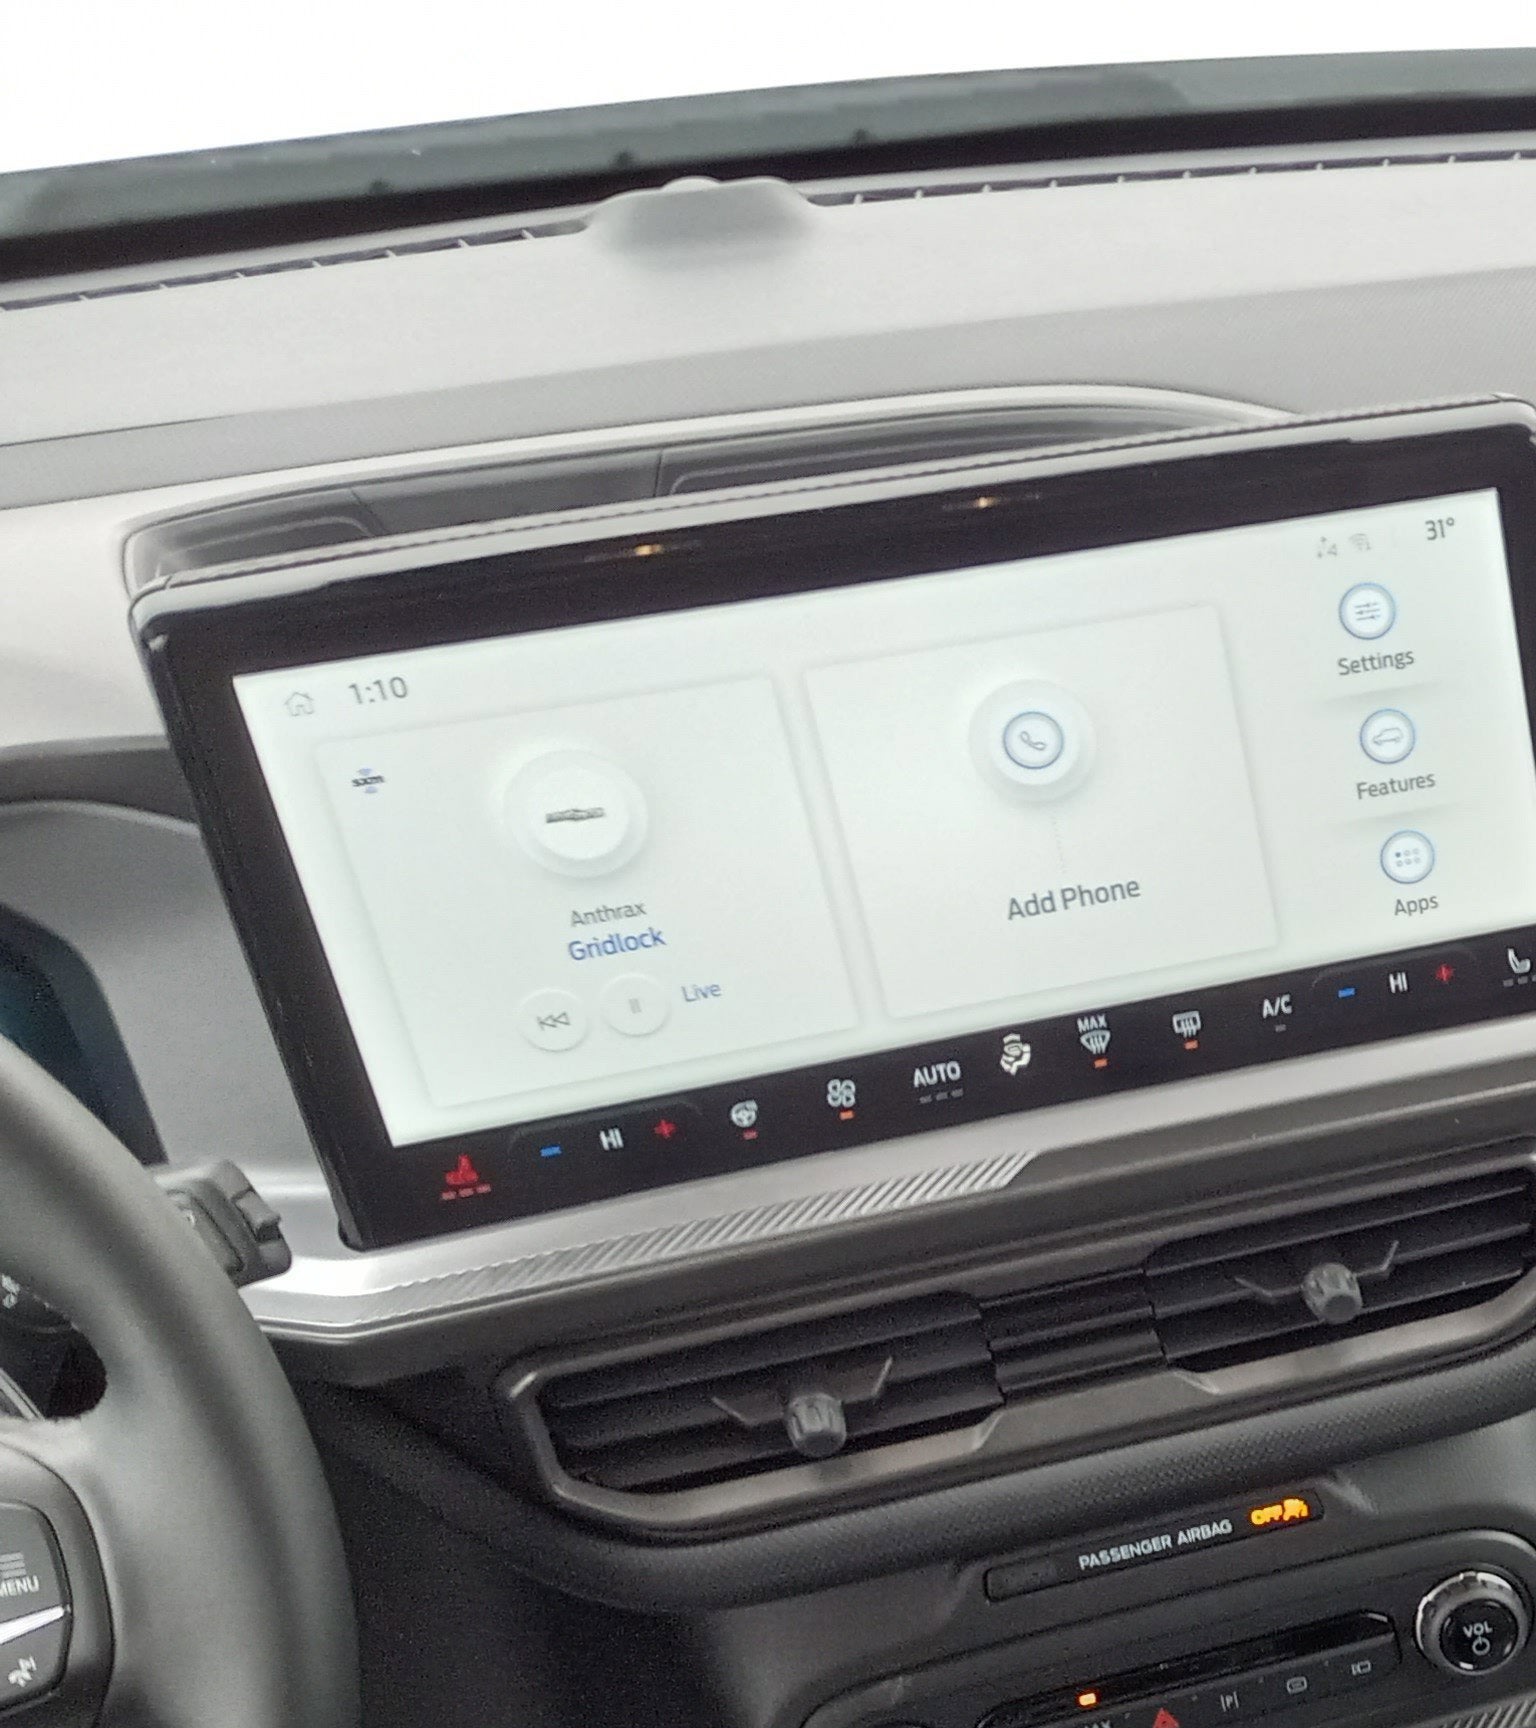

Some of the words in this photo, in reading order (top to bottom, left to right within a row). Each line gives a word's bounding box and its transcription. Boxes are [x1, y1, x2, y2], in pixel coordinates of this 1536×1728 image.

[1338, 650, 1415, 676] Settings
[349, 676, 408, 704] 1:10
[1356, 773, 1436, 800] Features
[1008, 889, 1057, 921] Add
[1060, 880, 1141, 911] Phone
[1394, 895, 1439, 917] Apps
[570, 902, 647, 928] Anthrax
[568, 927, 667, 961] Gridlock
[681, 983, 723, 1003] Live
[1389, 972, 1409, 993] HI
[1262, 994, 1293, 1019] A/C
[1076, 1013, 1108, 1033] MAX
[914, 1061, 961, 1088] AUTO
[600, 1127, 624, 1151] HI
[1078, 1533, 1173, 1570] PASSENGER
[1177, 1518, 1233, 1547] AIRBAG
[1250, 1504, 1283, 1526] OFF
[1463, 1620, 1493, 1639] VOL
